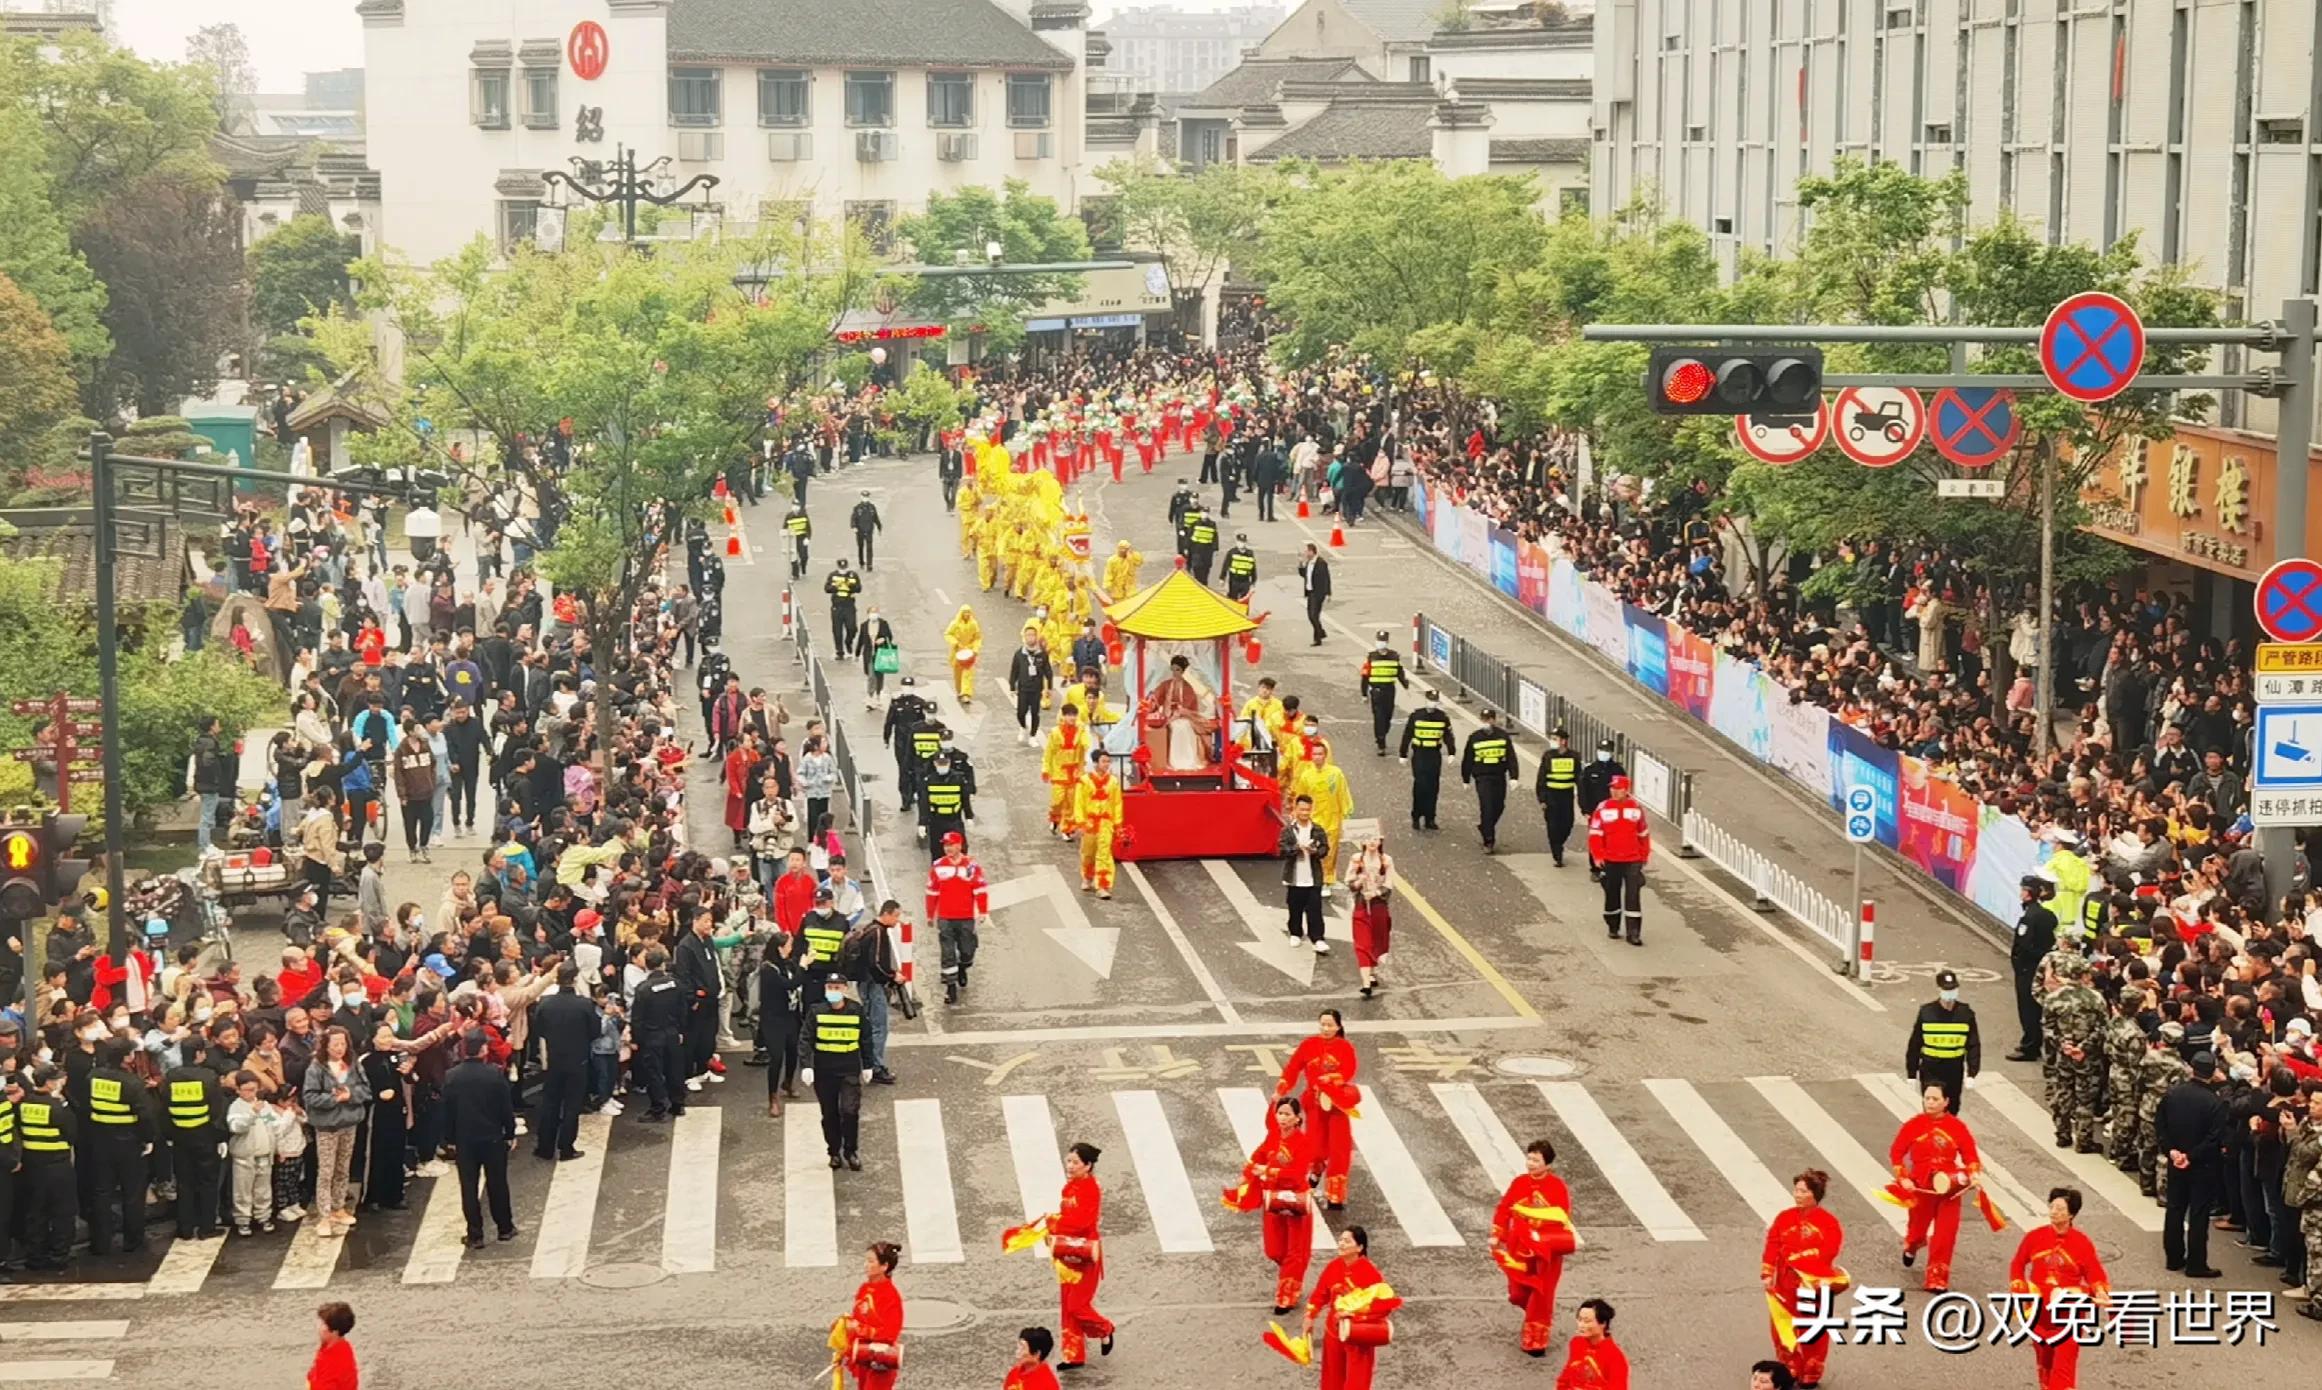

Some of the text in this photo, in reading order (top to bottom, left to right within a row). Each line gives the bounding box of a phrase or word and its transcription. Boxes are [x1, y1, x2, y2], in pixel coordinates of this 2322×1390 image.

[2264, 679, 2322, 695] 仙潭路
[2257, 798, 2322, 816] 违停抓拍
